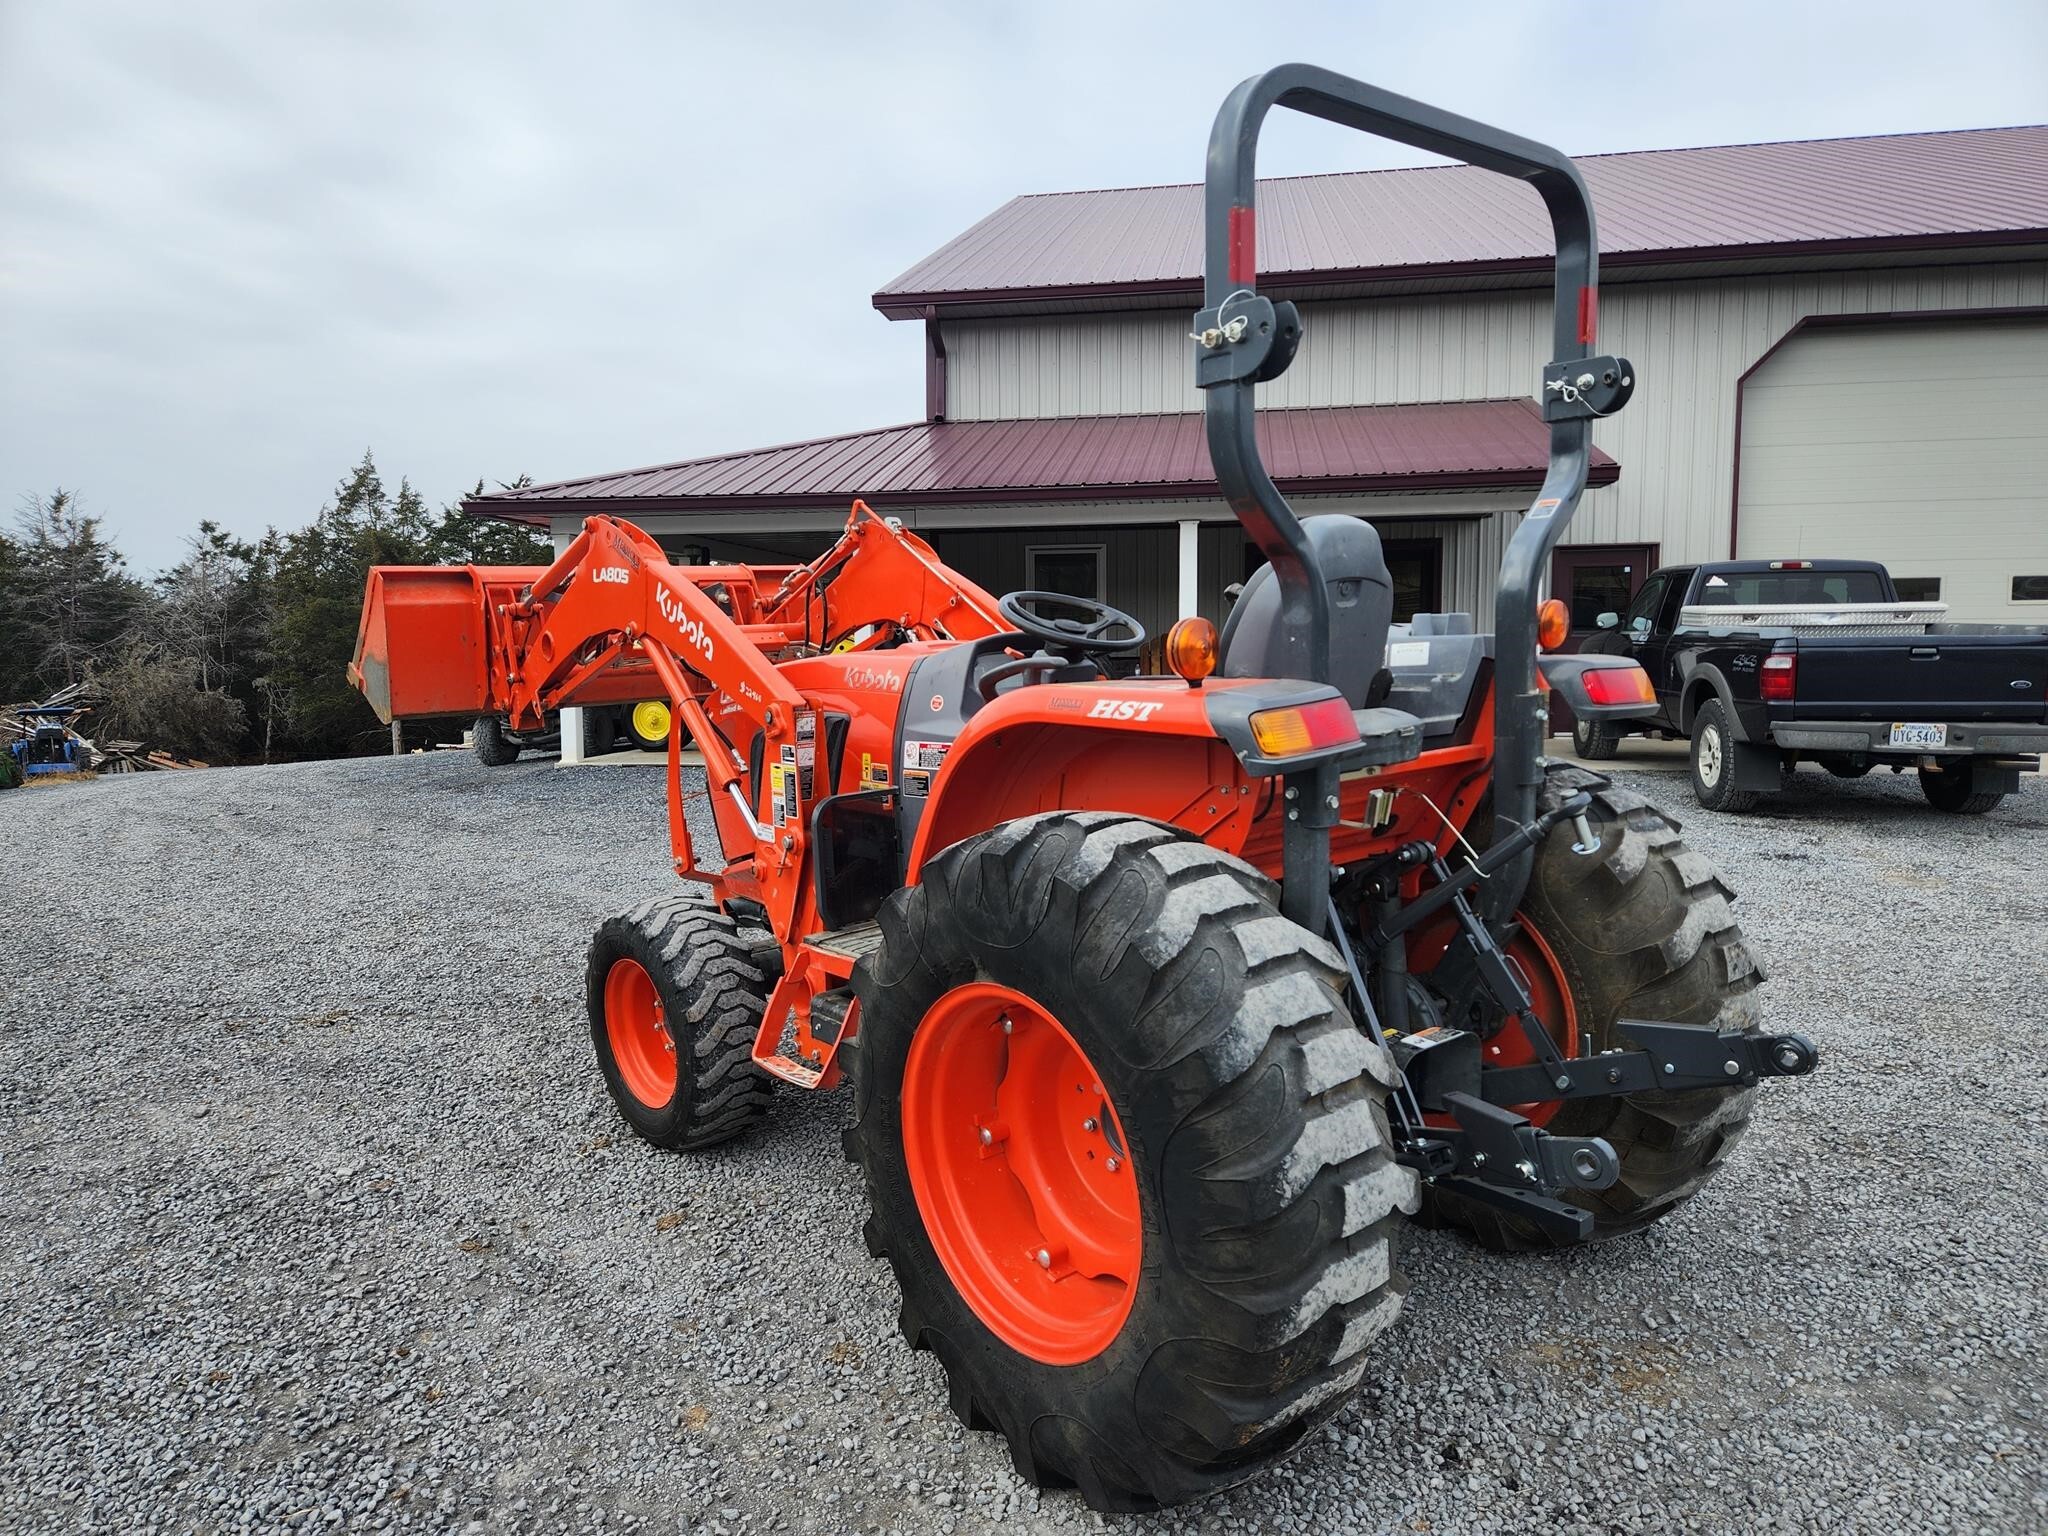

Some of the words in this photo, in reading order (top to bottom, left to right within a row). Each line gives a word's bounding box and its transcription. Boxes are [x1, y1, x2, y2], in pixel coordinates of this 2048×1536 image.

[592, 566, 630, 584] LA805
[656, 581, 714, 661] Kubota
[844, 665, 900, 692] Kubota
[1087, 699, 1164, 721] HST
